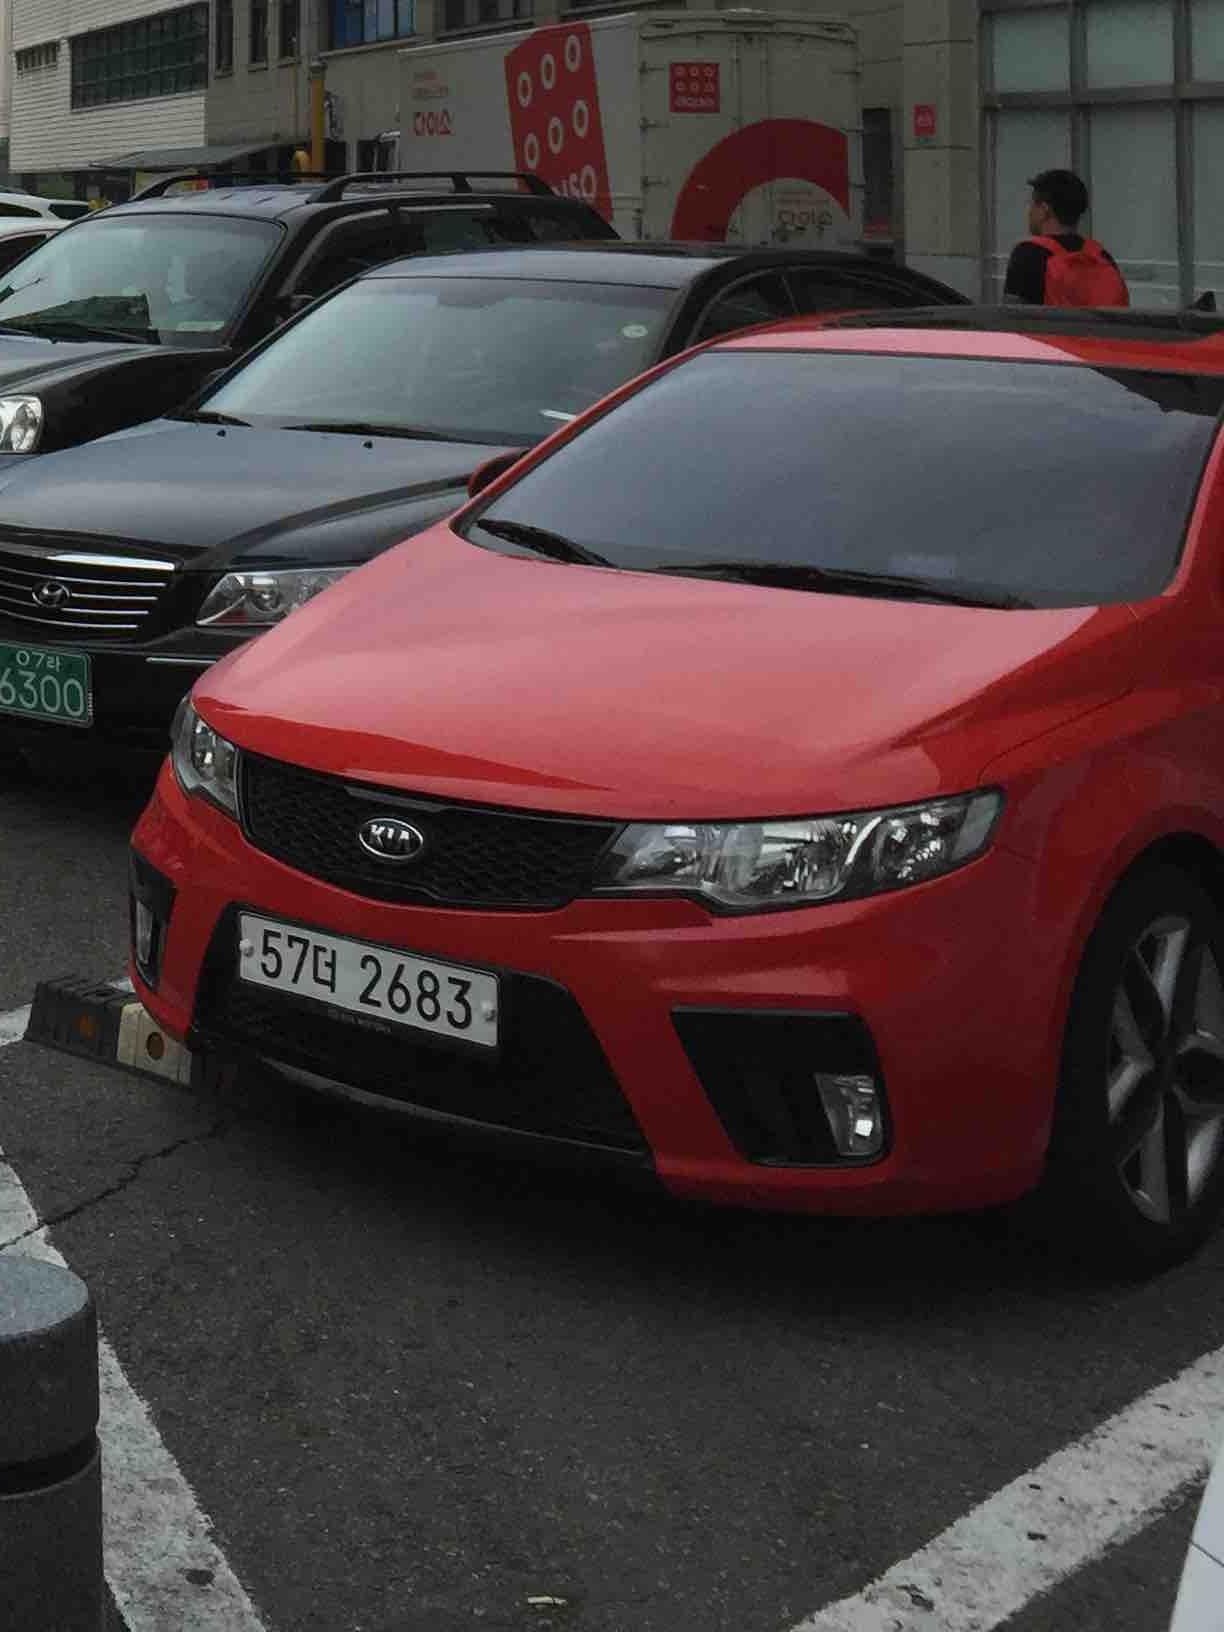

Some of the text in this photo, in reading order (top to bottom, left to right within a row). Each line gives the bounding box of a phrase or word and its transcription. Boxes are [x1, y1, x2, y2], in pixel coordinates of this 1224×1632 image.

[15, 649, 61, 672] 07라
[369, 823, 414, 852] KIA
[260, 928, 473, 1030] 57더 2683
